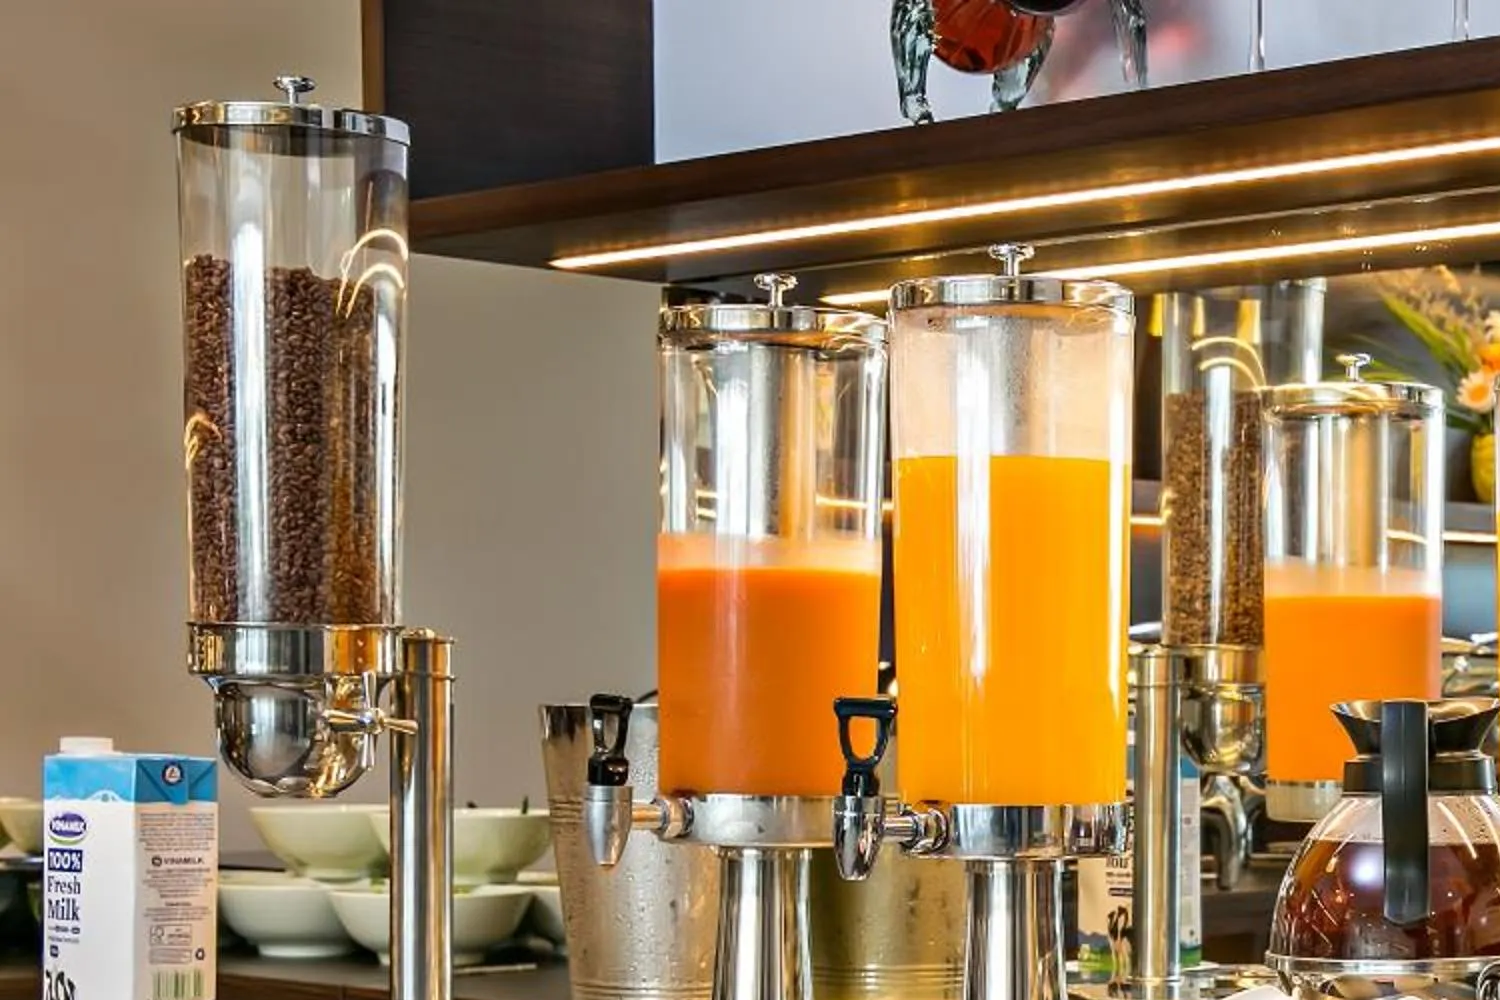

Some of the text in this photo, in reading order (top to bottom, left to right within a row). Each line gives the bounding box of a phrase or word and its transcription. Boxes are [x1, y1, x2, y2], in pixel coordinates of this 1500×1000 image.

[50, 851, 81, 870] 100%
[48, 876, 81, 895] Fresh
[48, 897, 80, 921] Milk
